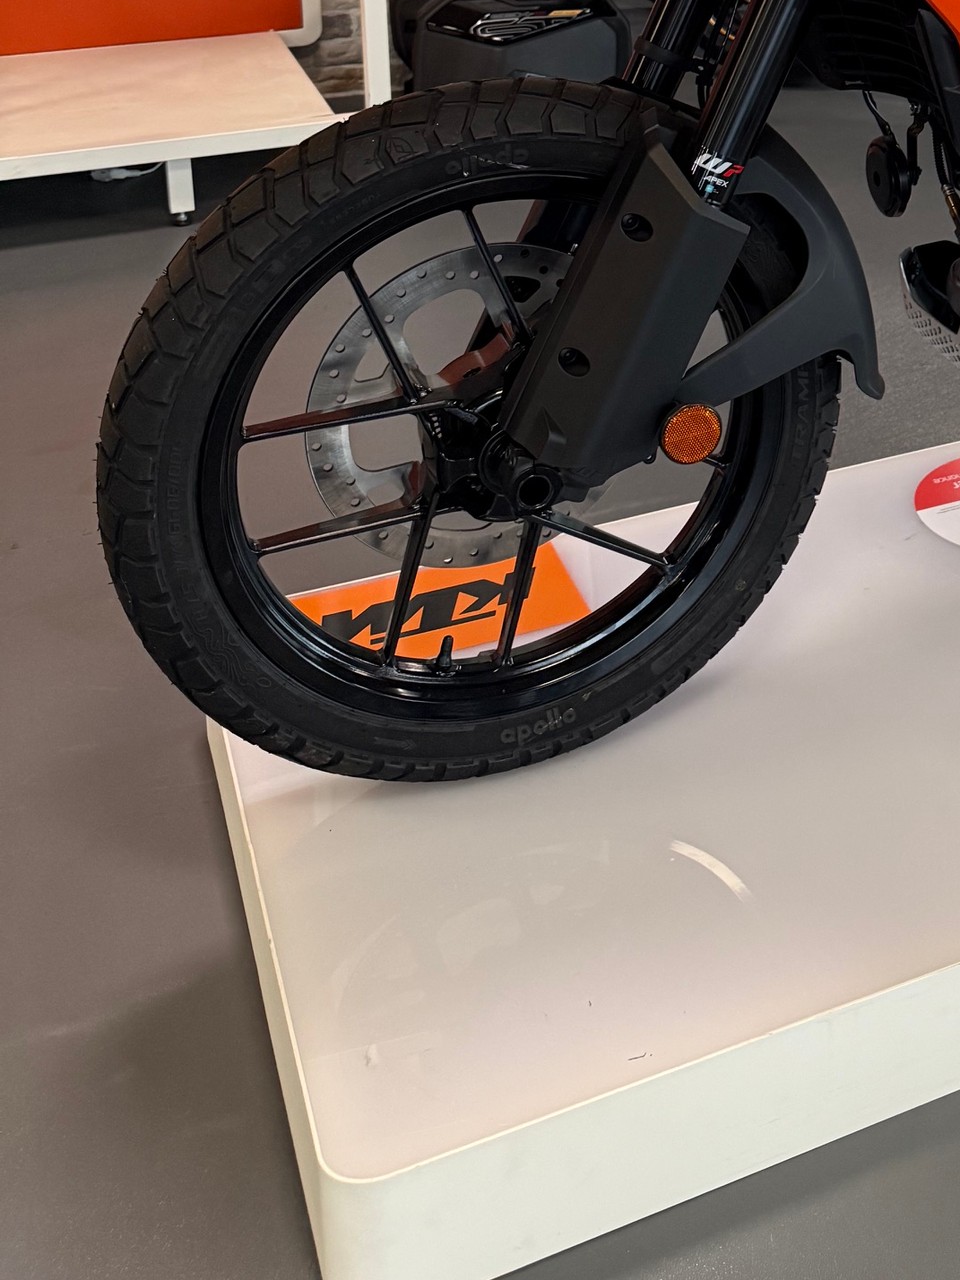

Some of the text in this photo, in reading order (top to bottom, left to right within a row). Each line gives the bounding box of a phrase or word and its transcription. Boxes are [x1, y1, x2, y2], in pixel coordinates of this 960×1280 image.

[703, 175, 729, 188] APEX
[321, 566, 536, 646] KTM
[500, 707, 577, 747] apollo
